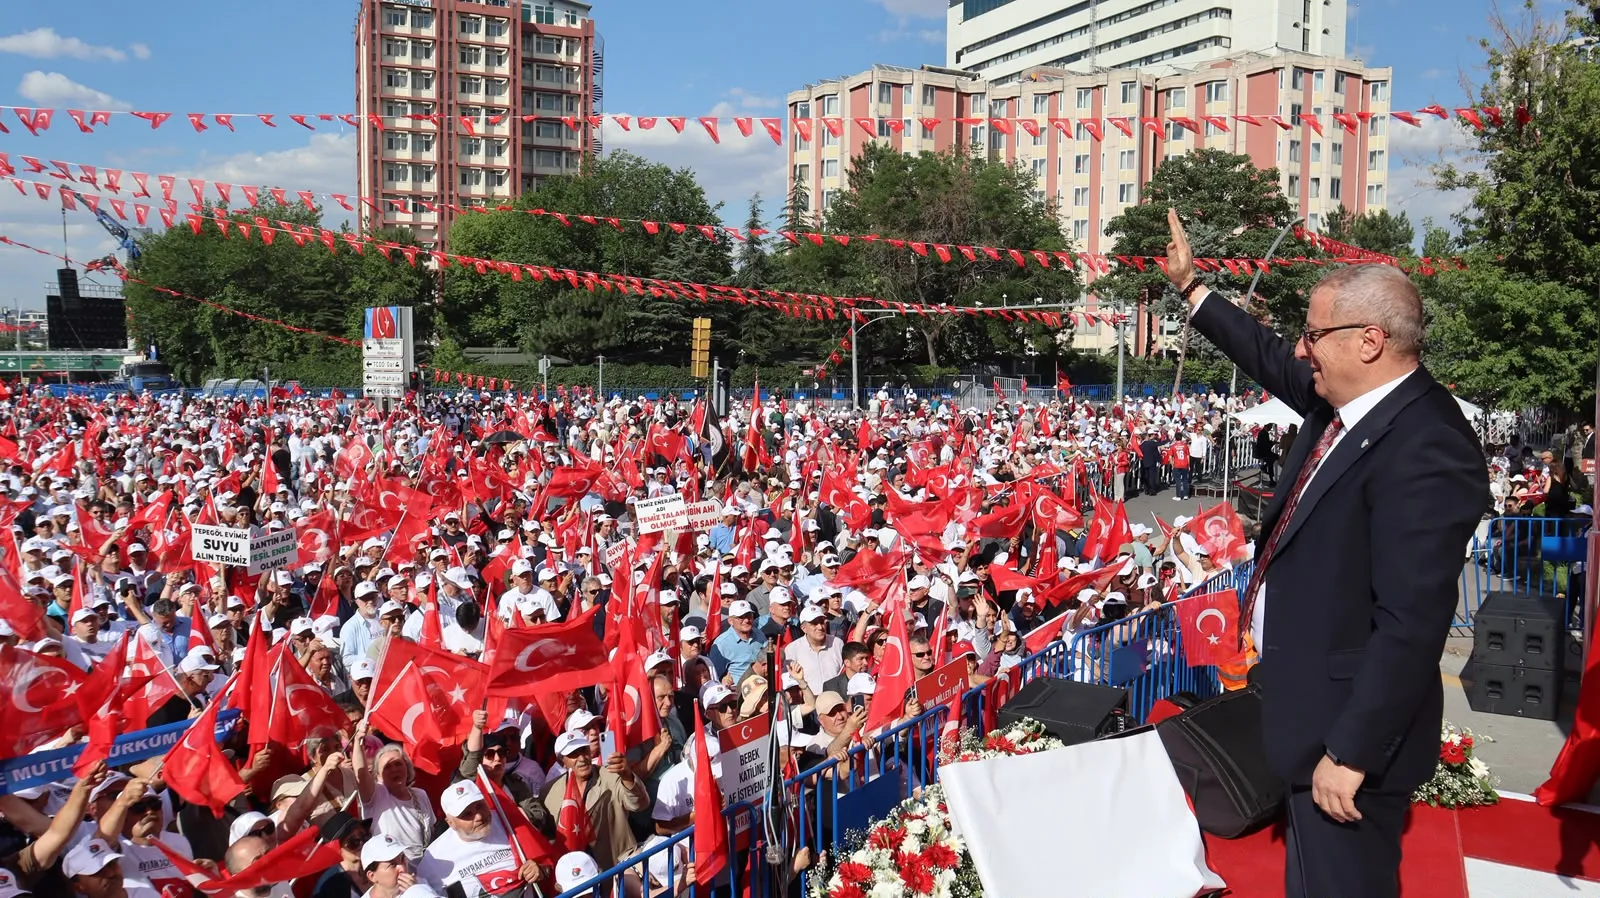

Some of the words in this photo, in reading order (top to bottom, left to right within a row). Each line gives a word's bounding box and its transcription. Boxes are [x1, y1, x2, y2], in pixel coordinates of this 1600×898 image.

[661, 509, 686, 520] TALAN
[224, 530, 248, 540] EVİMİZ
[281, 532, 294, 542] ADI
[203, 538, 239, 553] SUYU
[195, 551, 214, 561] ALIN
[215, 554, 248, 565] TERİMİZ
[740, 747, 760, 767] BEBEK
[12, 755, 80, 782] MUTL
[739, 762, 766, 784] KATİLİNE
[737, 775, 772, 801] İSTEYENLR
[458, 859, 485, 879] BAYRAK
